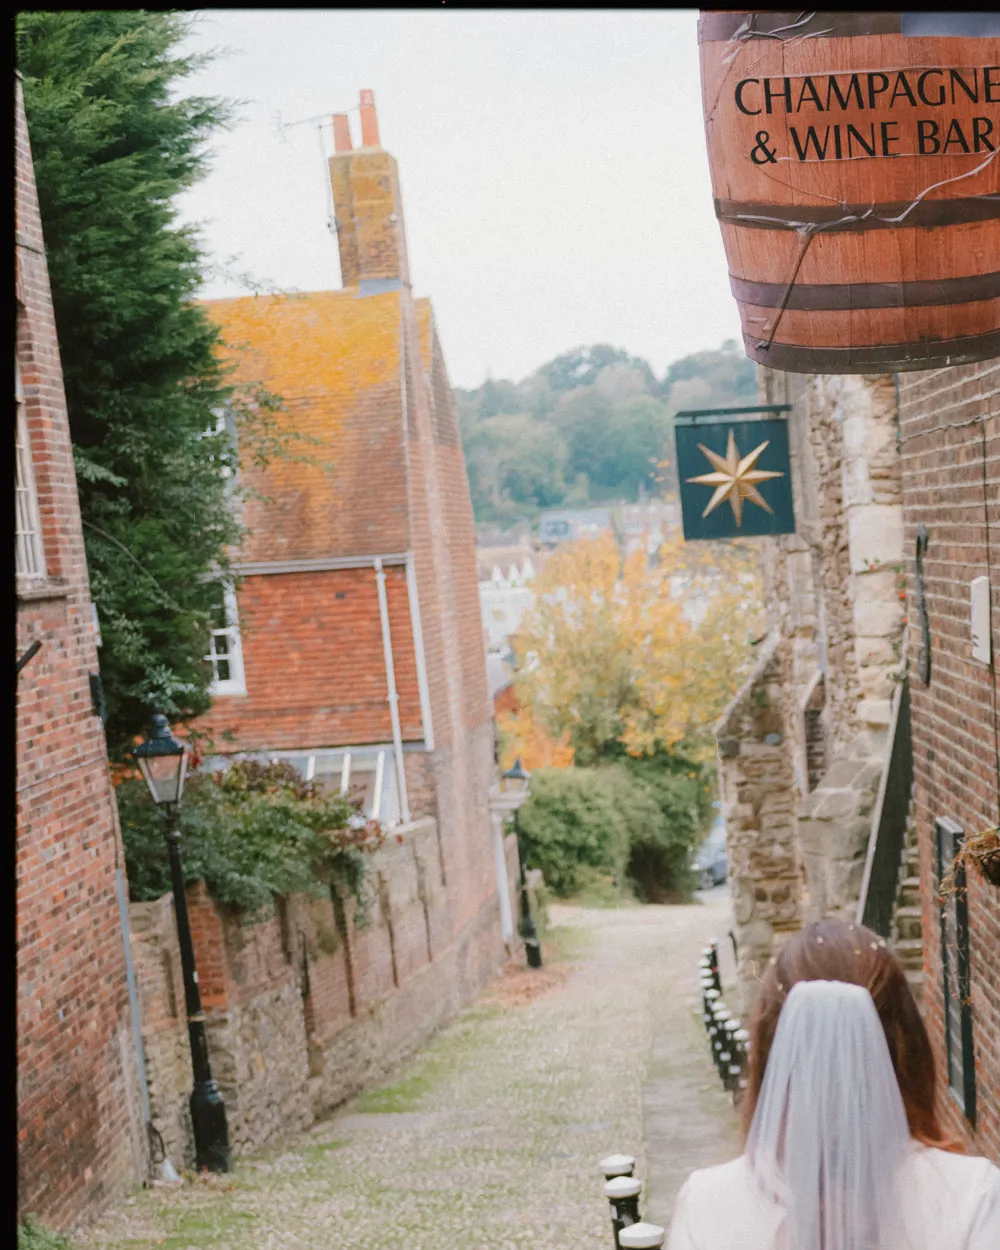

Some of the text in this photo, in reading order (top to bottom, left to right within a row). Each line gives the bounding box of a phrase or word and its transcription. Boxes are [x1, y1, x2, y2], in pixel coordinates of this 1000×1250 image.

[750, 116, 997, 165] & WINE BAR
